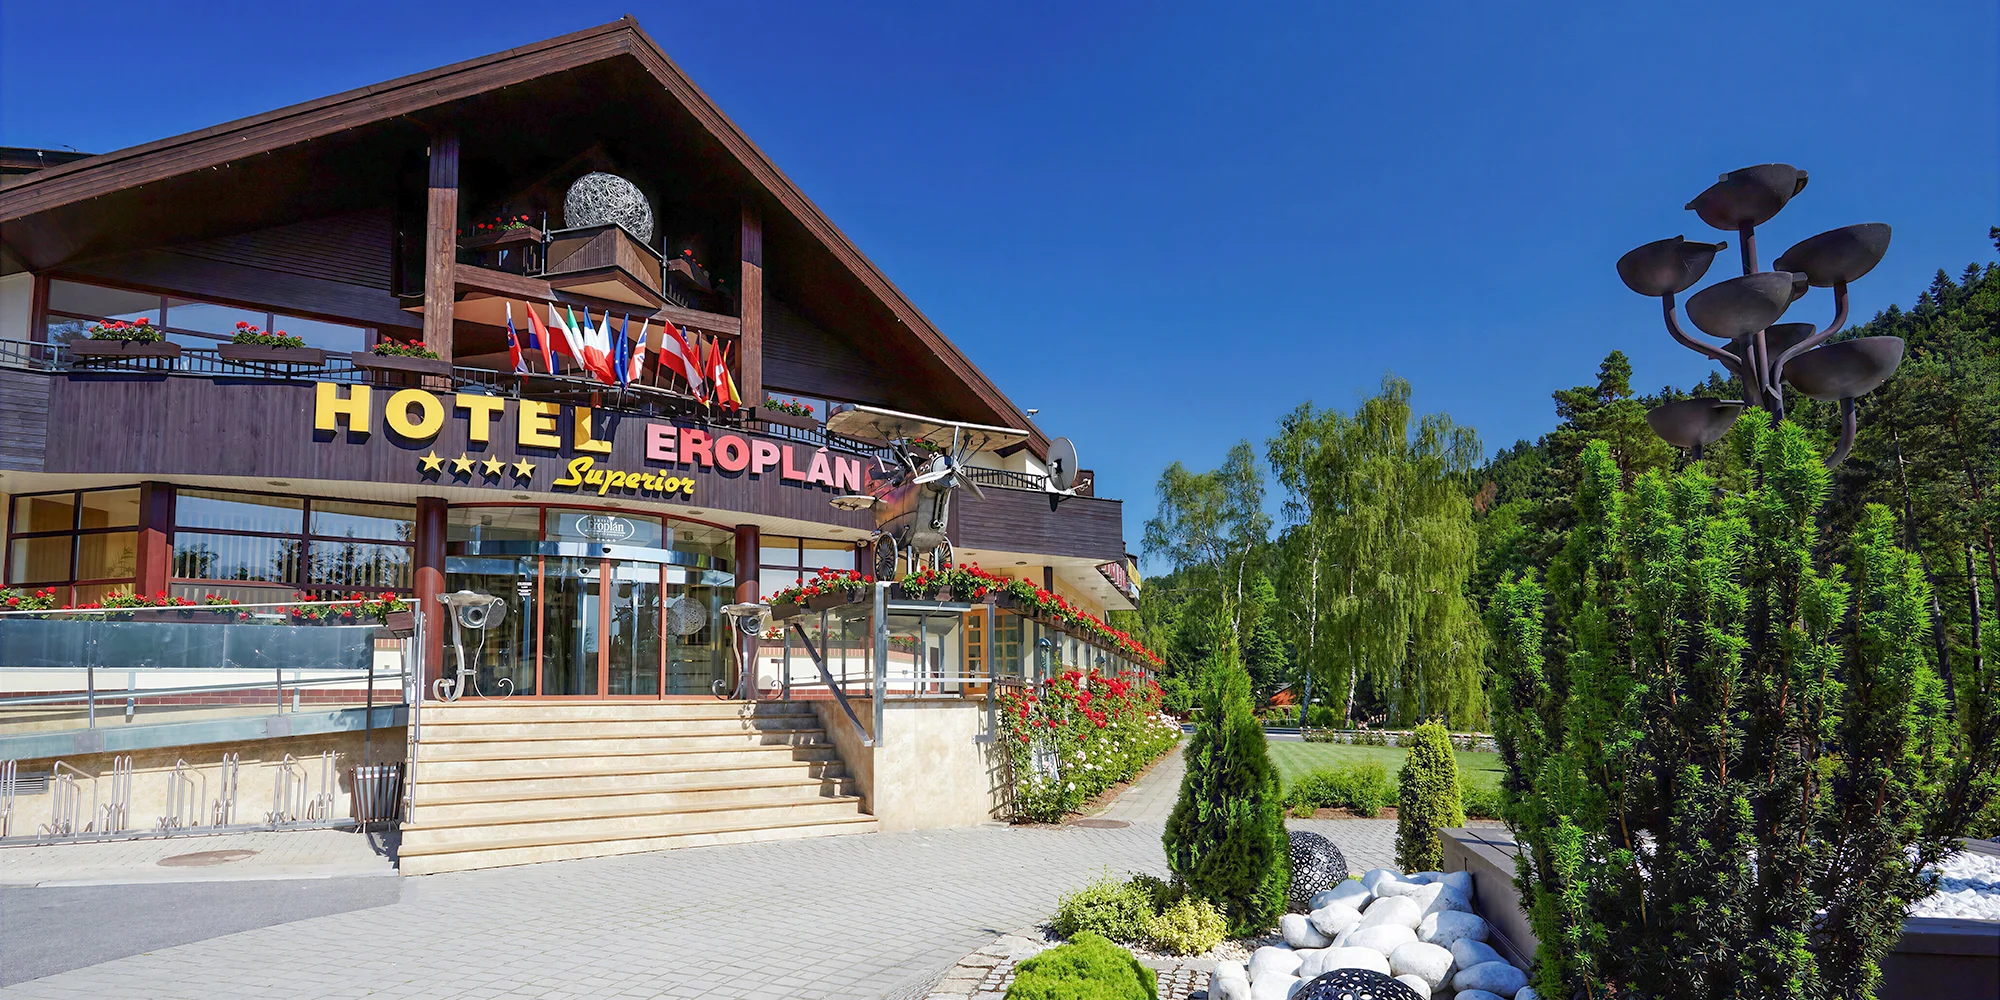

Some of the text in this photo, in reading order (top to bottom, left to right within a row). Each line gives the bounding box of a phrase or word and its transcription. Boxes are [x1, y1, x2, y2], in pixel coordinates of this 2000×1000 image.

[315, 382, 861, 492] HOTEL EROPLÁN
[553, 456, 695, 495] Superior
